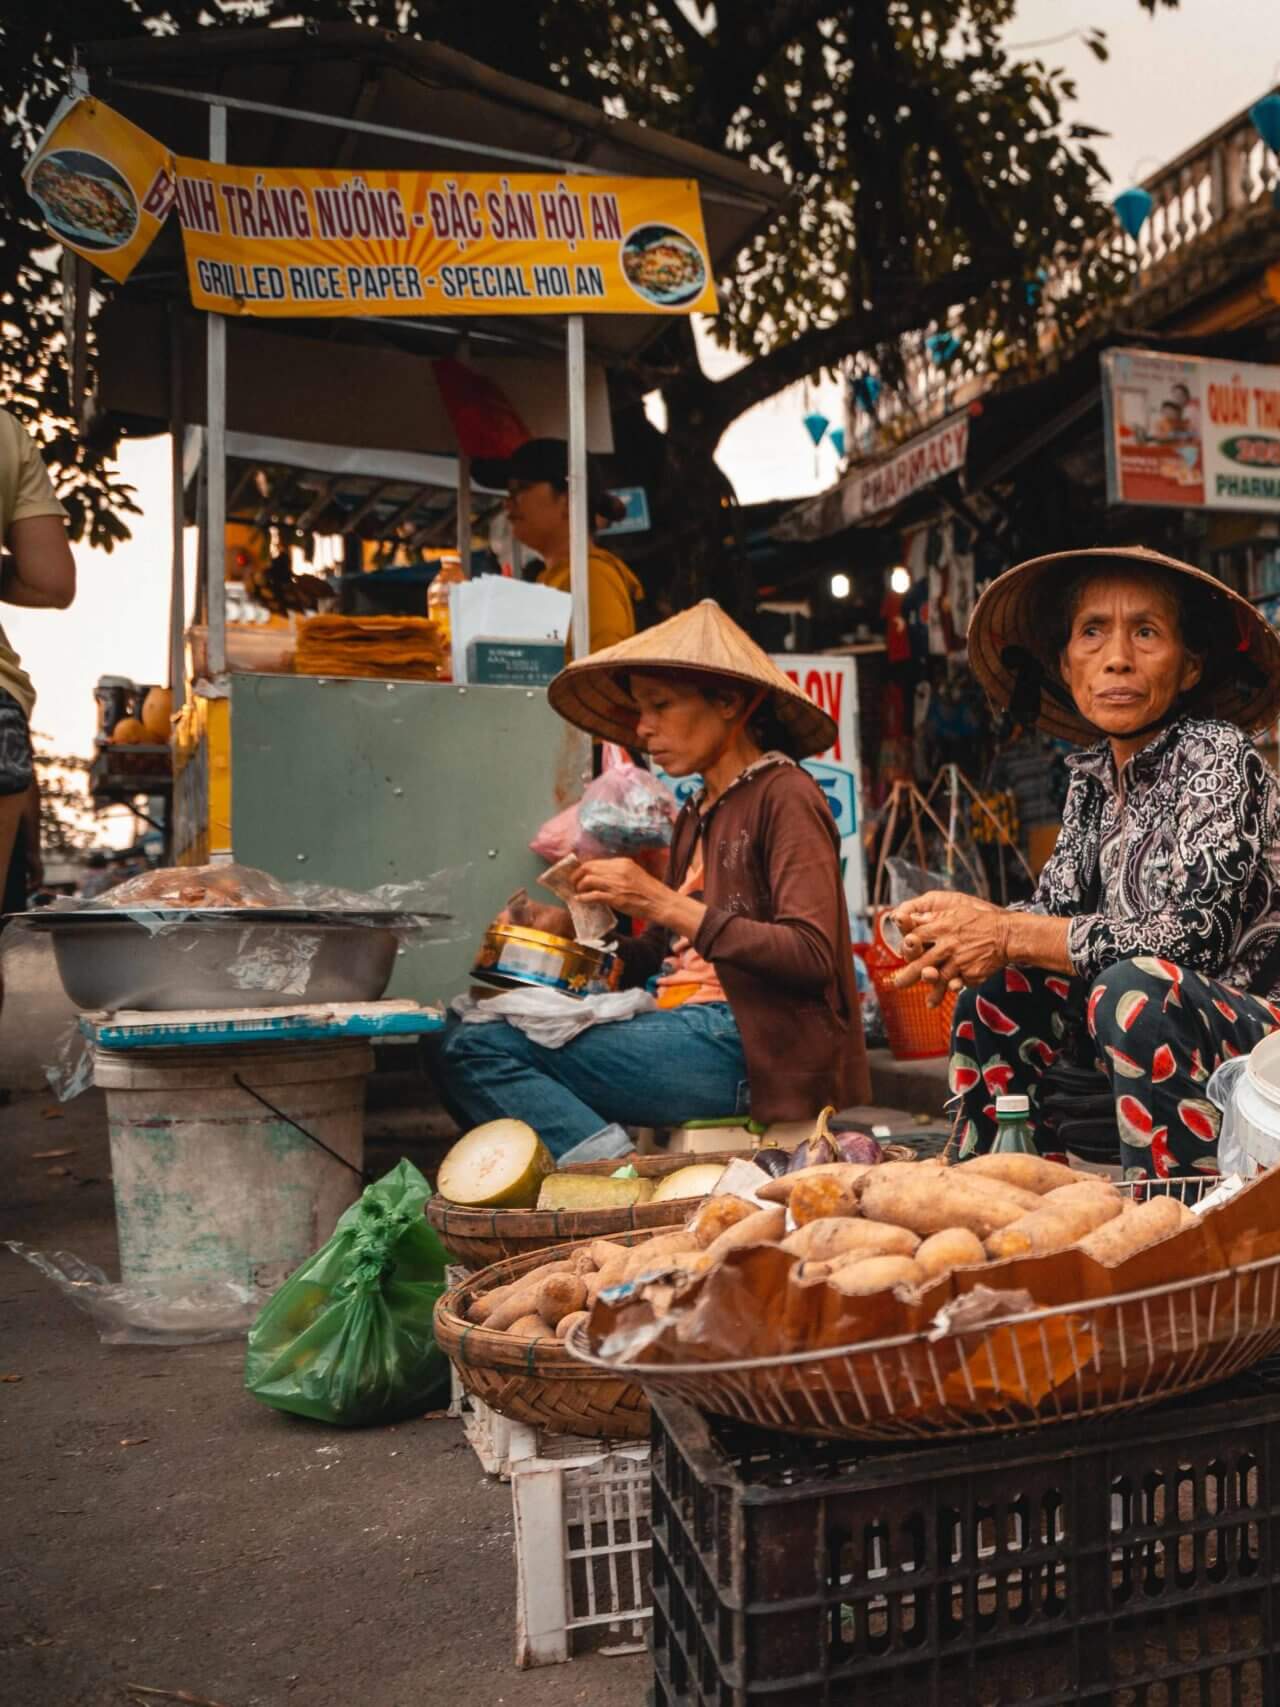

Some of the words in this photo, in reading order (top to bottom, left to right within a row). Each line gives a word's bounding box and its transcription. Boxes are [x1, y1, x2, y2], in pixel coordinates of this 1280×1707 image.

[222, 175, 311, 238] TRÁNG
[315, 177, 407, 238] NƯỚNG
[430, 182, 482, 250] ĐẶC
[488, 179, 537, 240] SẢN
[541, 183, 585, 251] HỘI
[591, 195, 623, 240] AN
[197, 260, 285, 299] GRILLED
[288, 266, 344, 299] RICE
[347, 266, 421, 298] PAPER
[440, 266, 531, 297] SPECIAL
[533, 267, 571, 296] HOI
[576, 267, 605, 296] AN
[862, 422, 968, 508] PHARMACY
